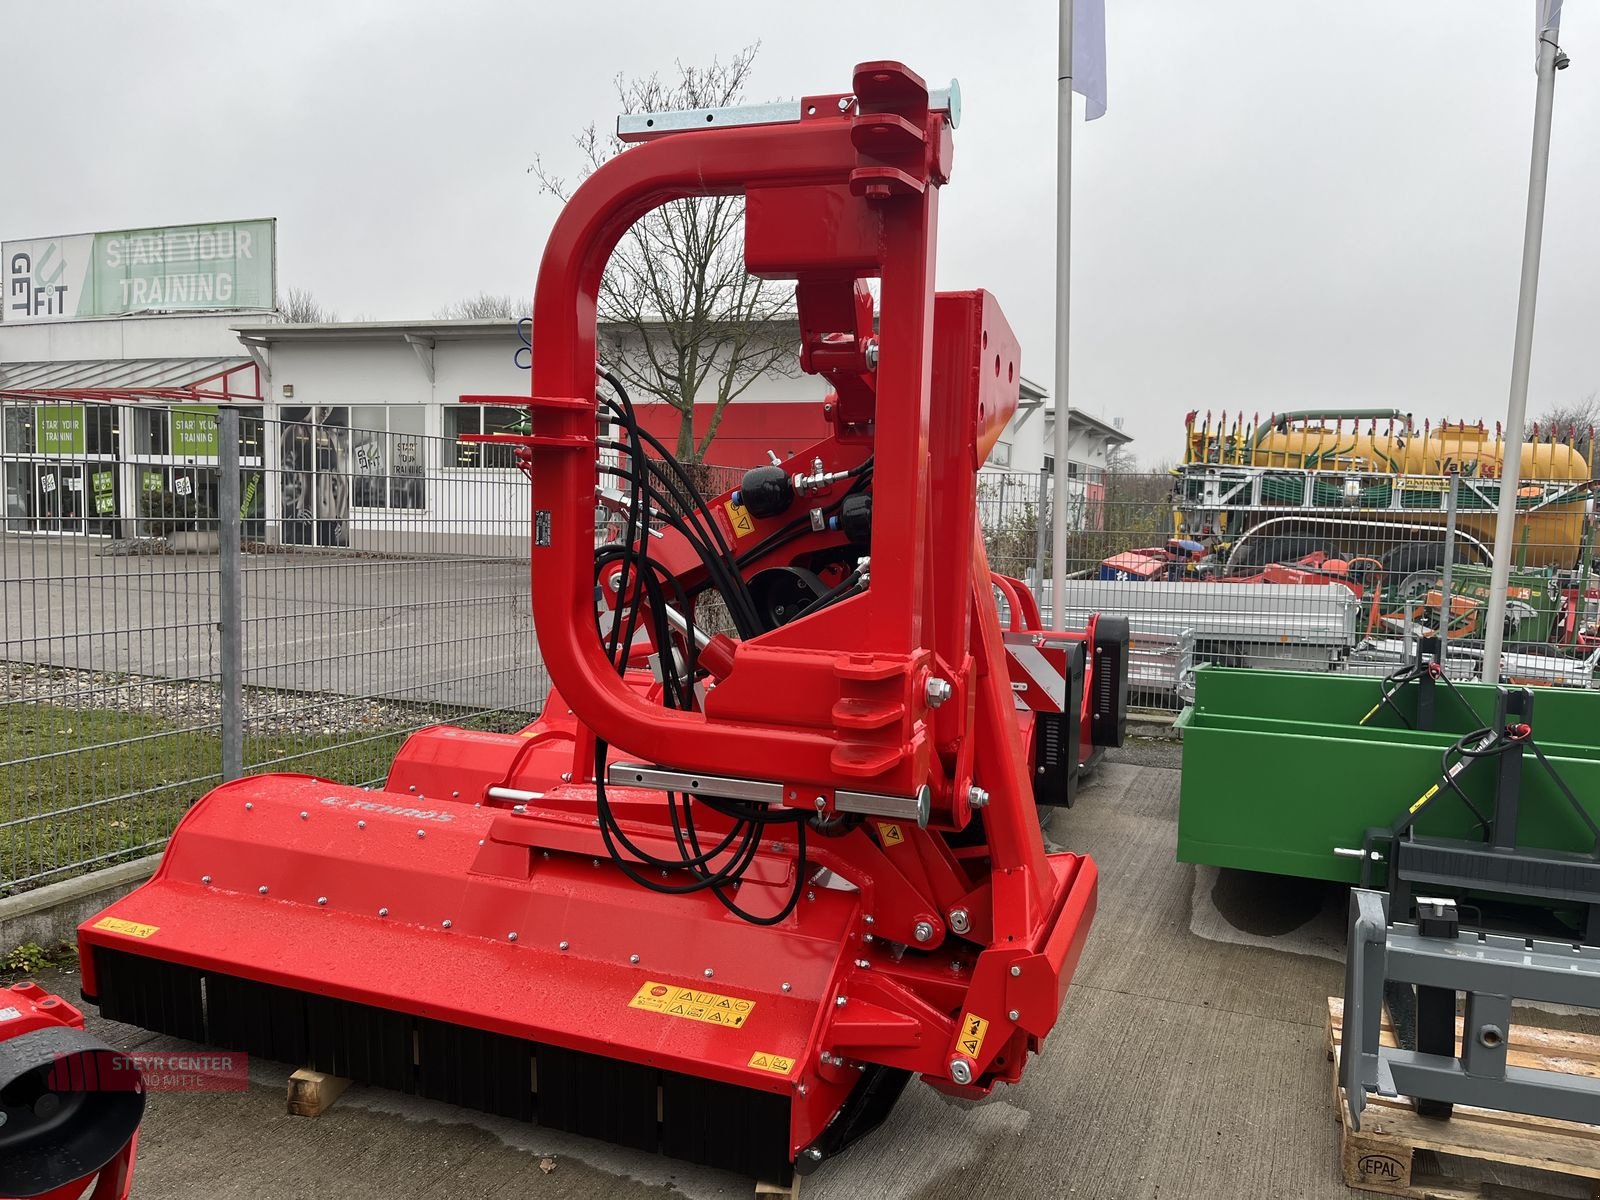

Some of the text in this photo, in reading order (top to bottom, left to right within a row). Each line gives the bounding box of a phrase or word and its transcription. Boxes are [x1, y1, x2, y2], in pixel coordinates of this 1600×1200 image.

[106, 230, 253, 267] START YOUR
[11, 252, 31, 316] GET
[120, 273, 233, 306] TRAINING
[180, 433, 213, 443] TRAINING
[1366, 1159, 1399, 1178] EPAL
